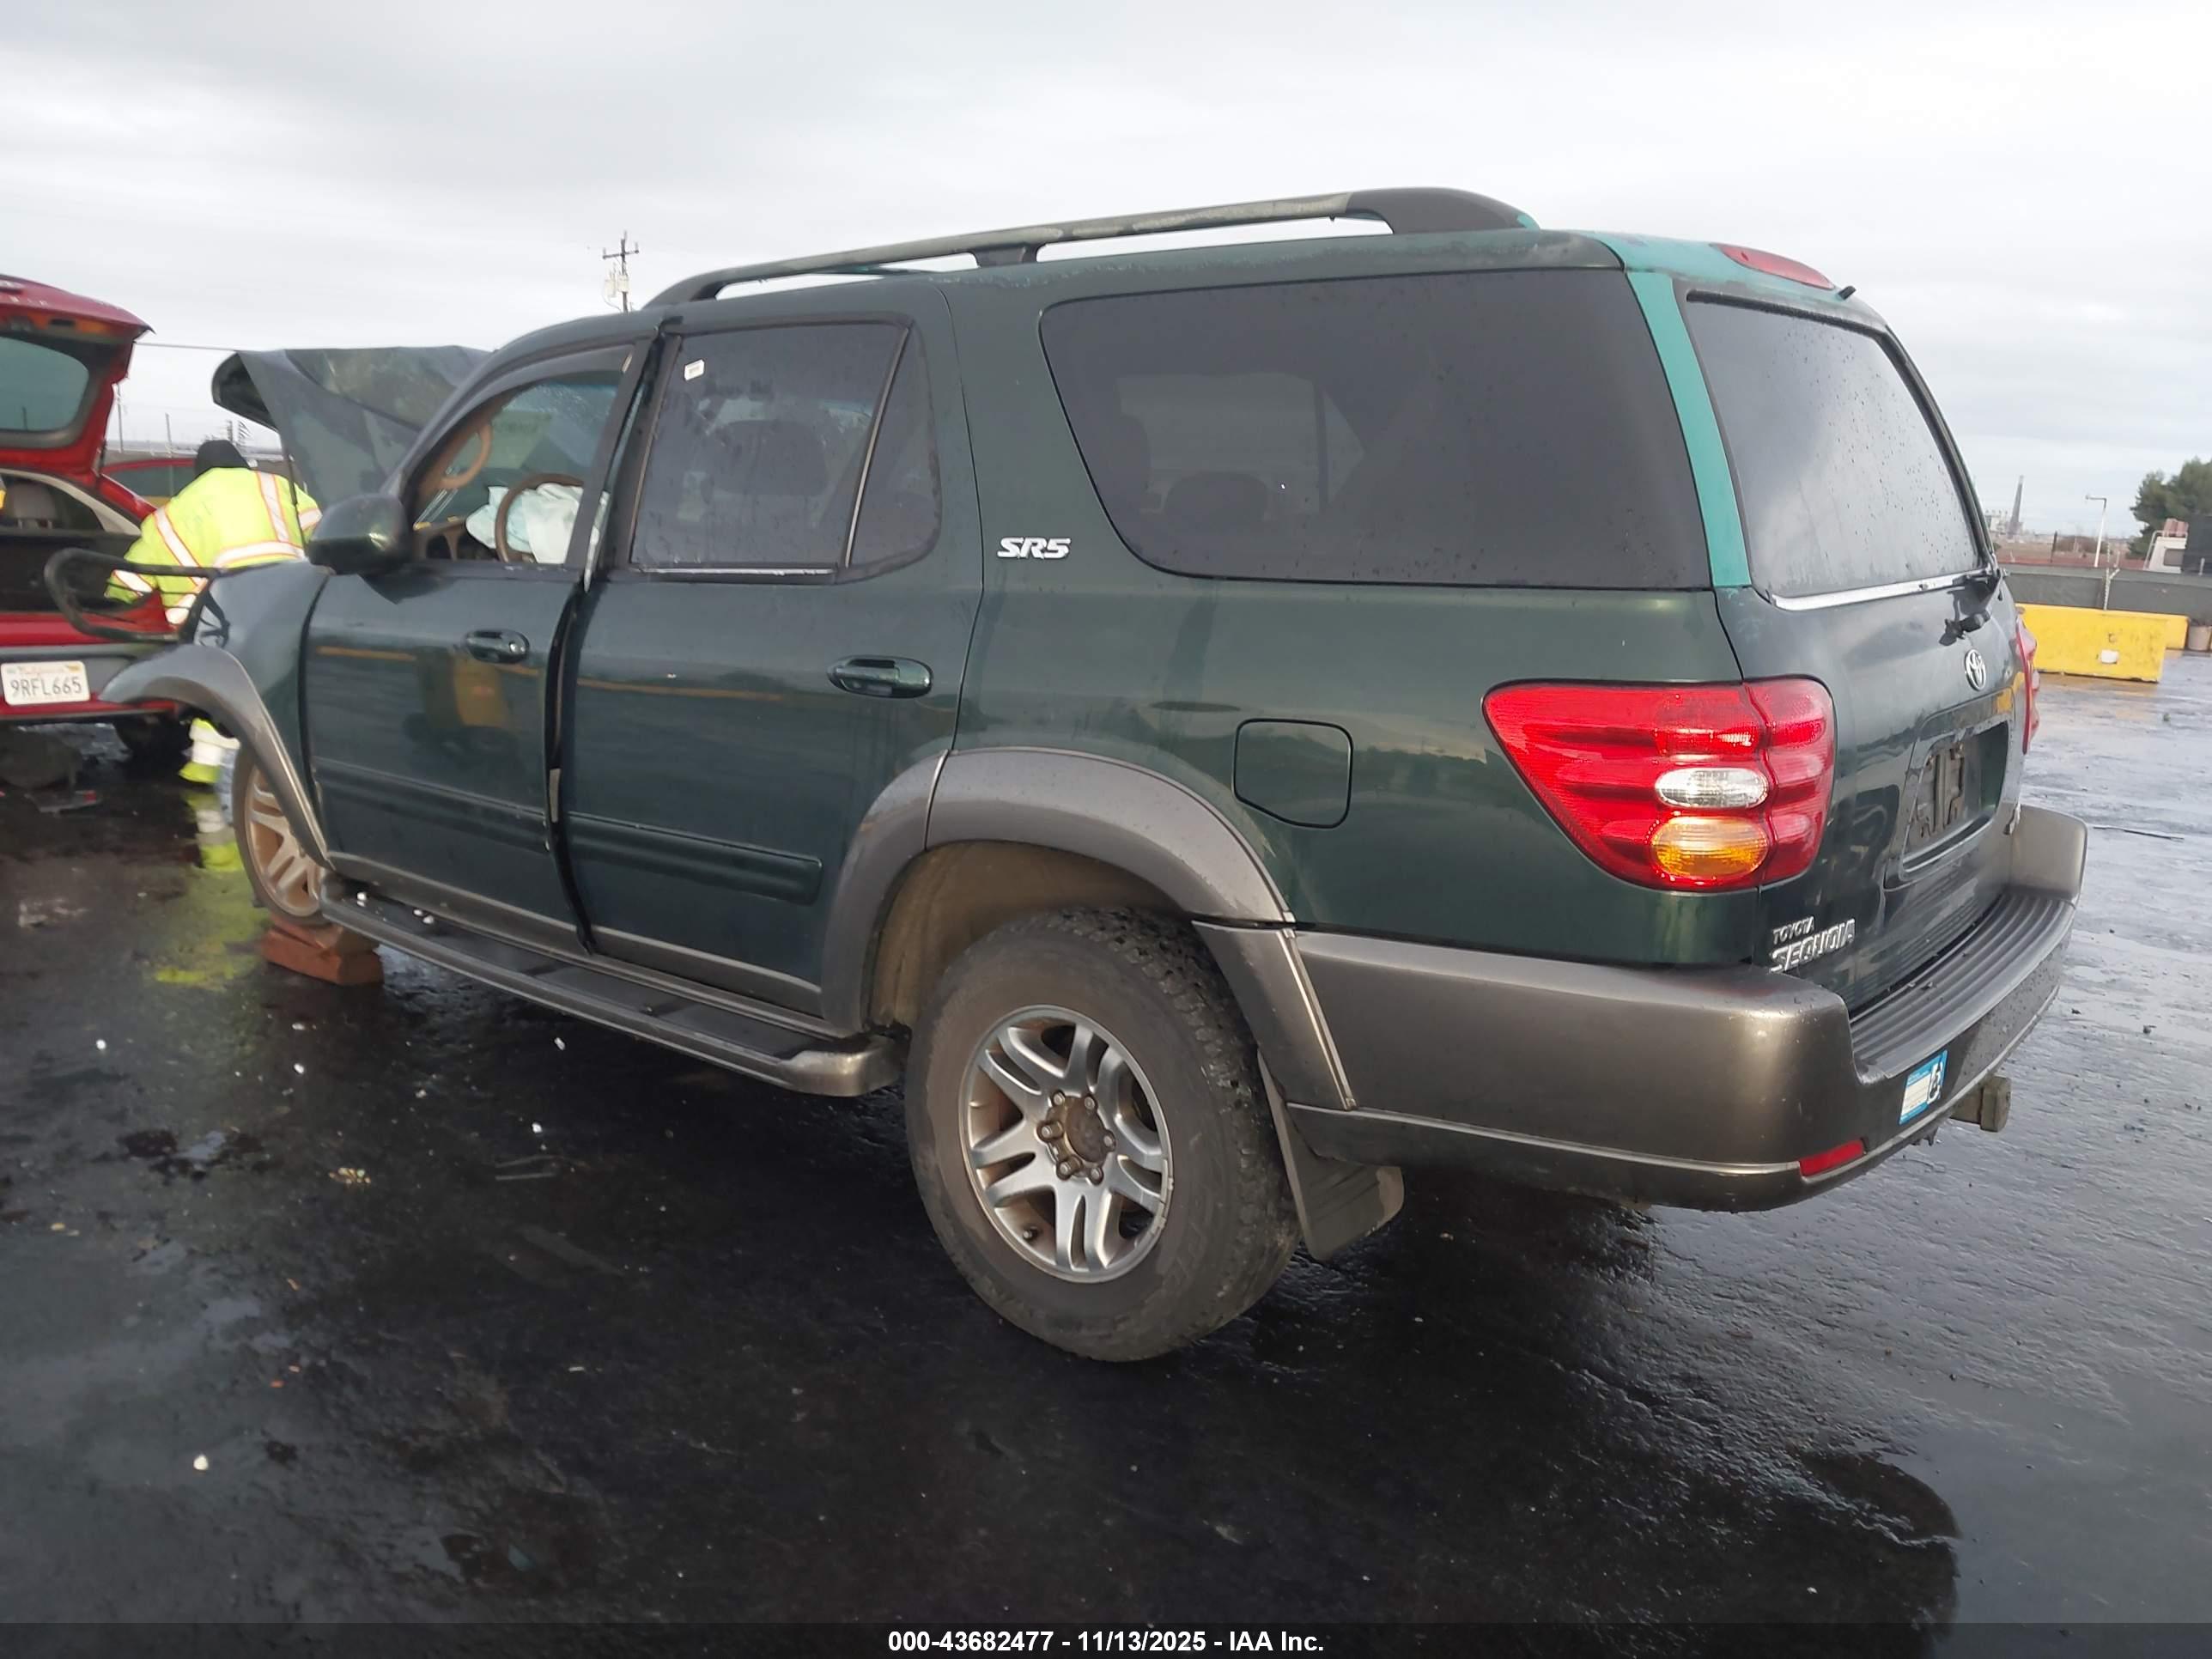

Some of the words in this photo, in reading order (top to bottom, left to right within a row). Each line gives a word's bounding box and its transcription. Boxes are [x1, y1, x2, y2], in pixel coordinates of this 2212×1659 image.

[997, 537, 1071, 559] SR5
[9, 677, 82, 698] 9RFL665
[1772, 915, 1814, 945] TOYOTA
